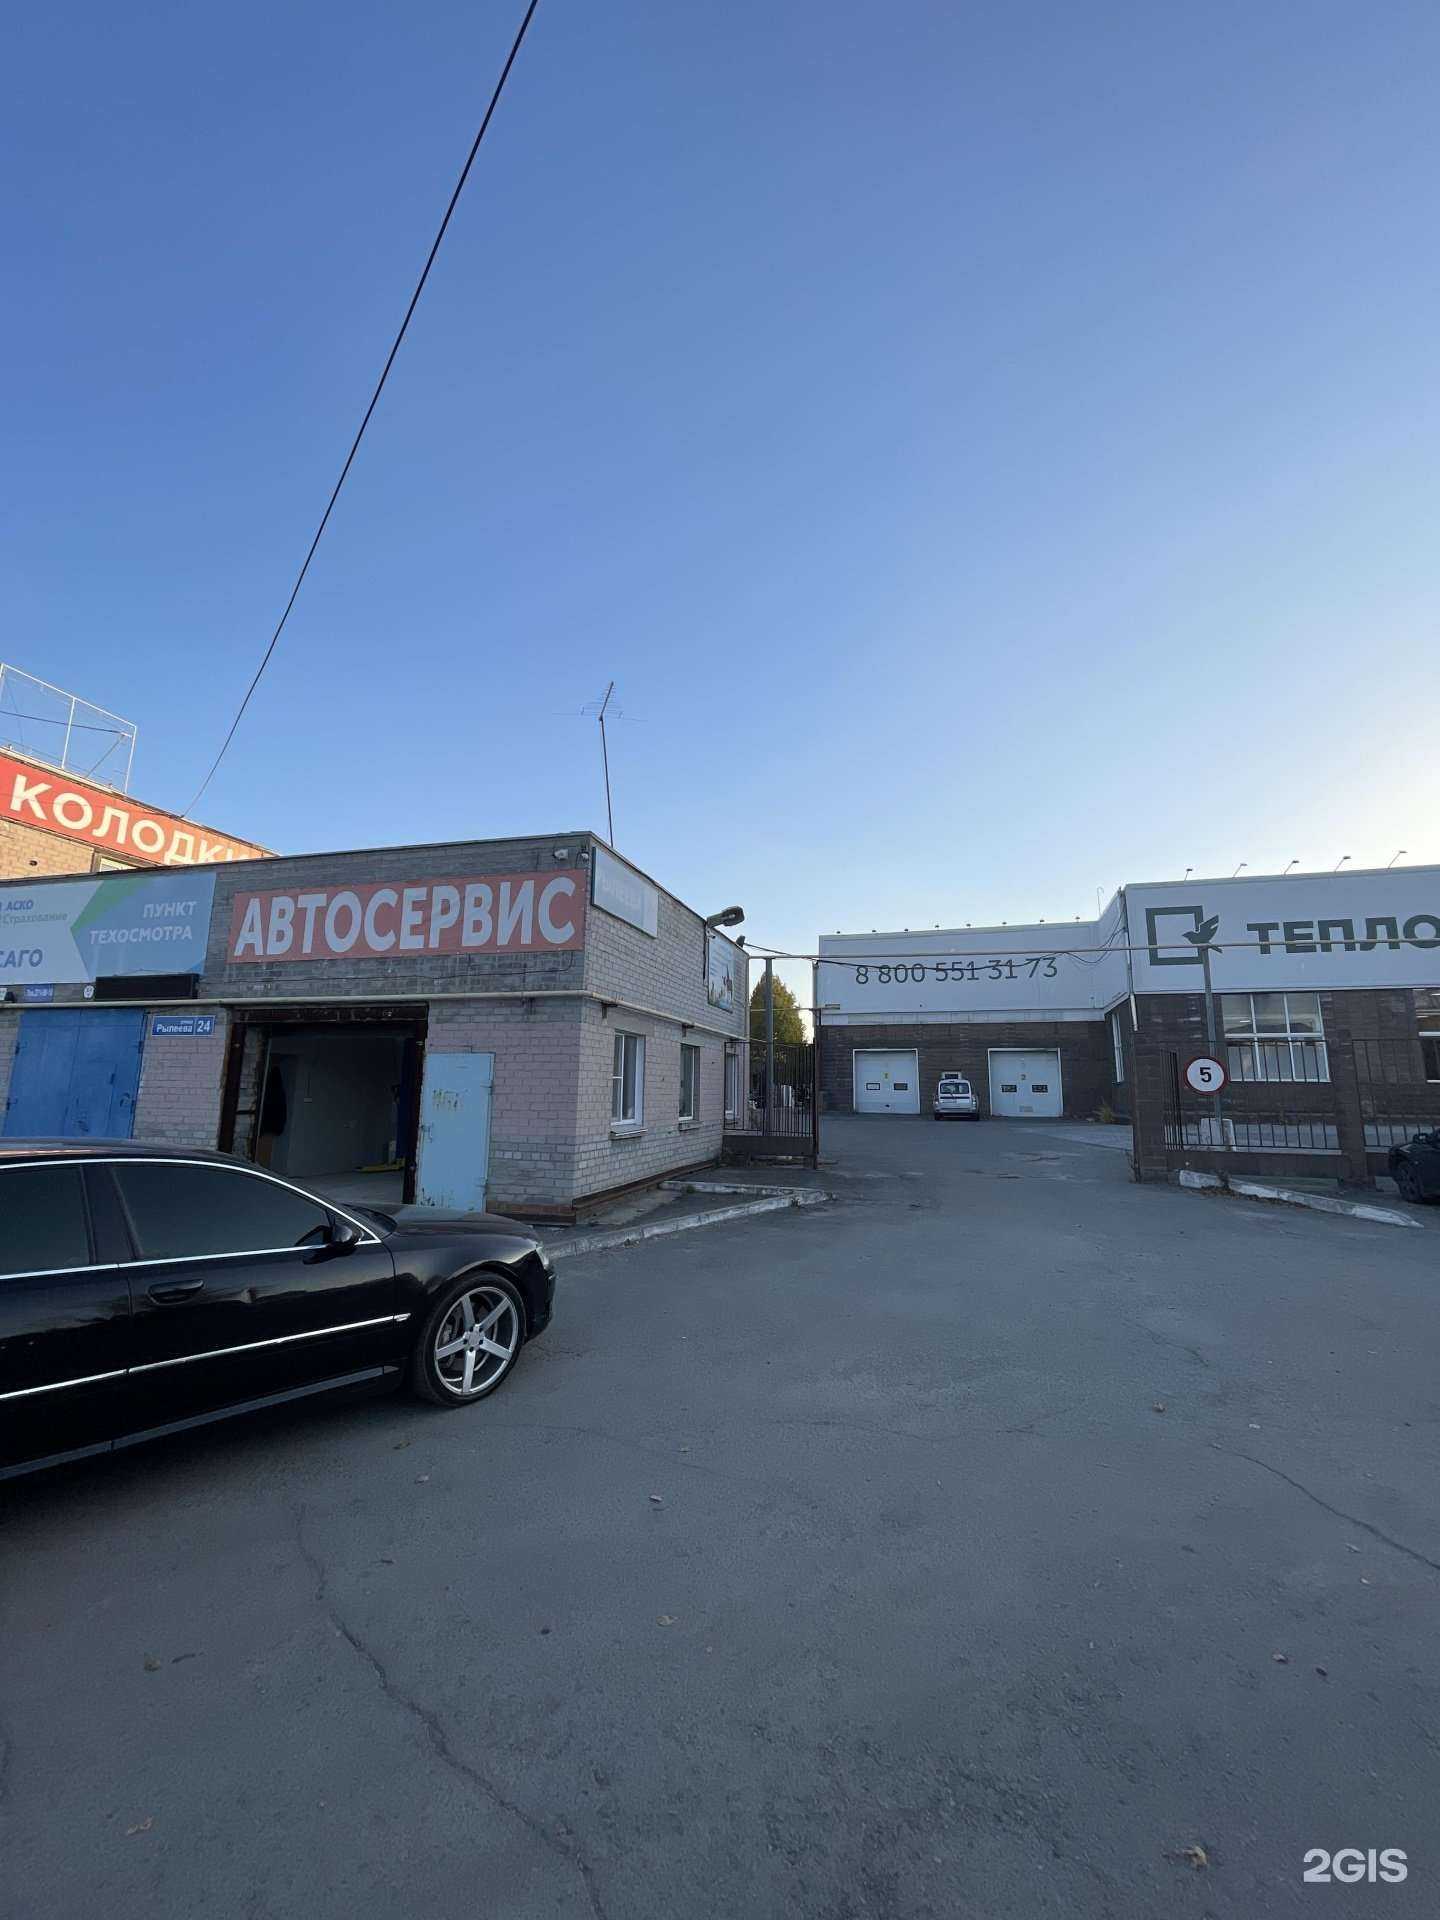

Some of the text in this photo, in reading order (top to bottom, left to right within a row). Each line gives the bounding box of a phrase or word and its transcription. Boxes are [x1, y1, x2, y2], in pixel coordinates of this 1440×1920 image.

[143, 901, 197, 918] ПУНКТ
[234, 877, 576, 957] АВТОСЕРВИС
[89, 926, 193, 945] ТЕХОСМОТРА
[1246, 914, 1440, 955] ТЕПЛО
[855, 957, 1058, 985] 8 800 551 31 73
[197, 1020, 211, 1033] 24
[1199, 1066, 1212, 1083] 5
